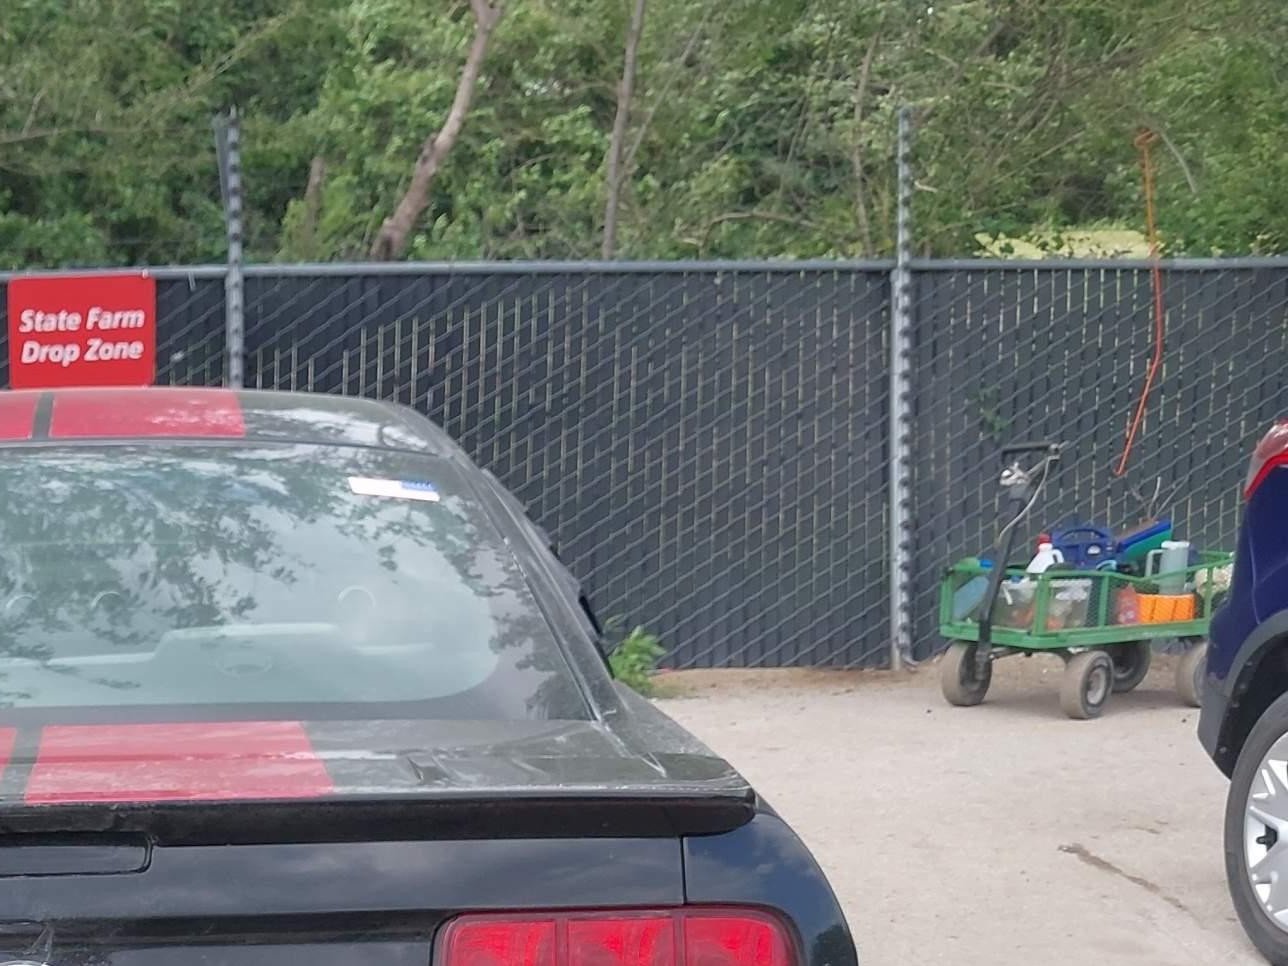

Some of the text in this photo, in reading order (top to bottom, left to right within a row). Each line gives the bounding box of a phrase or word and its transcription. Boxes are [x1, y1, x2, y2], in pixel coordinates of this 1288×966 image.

[18, 307, 145, 332] State Farm
[22, 338, 144, 367] Drop Zone
